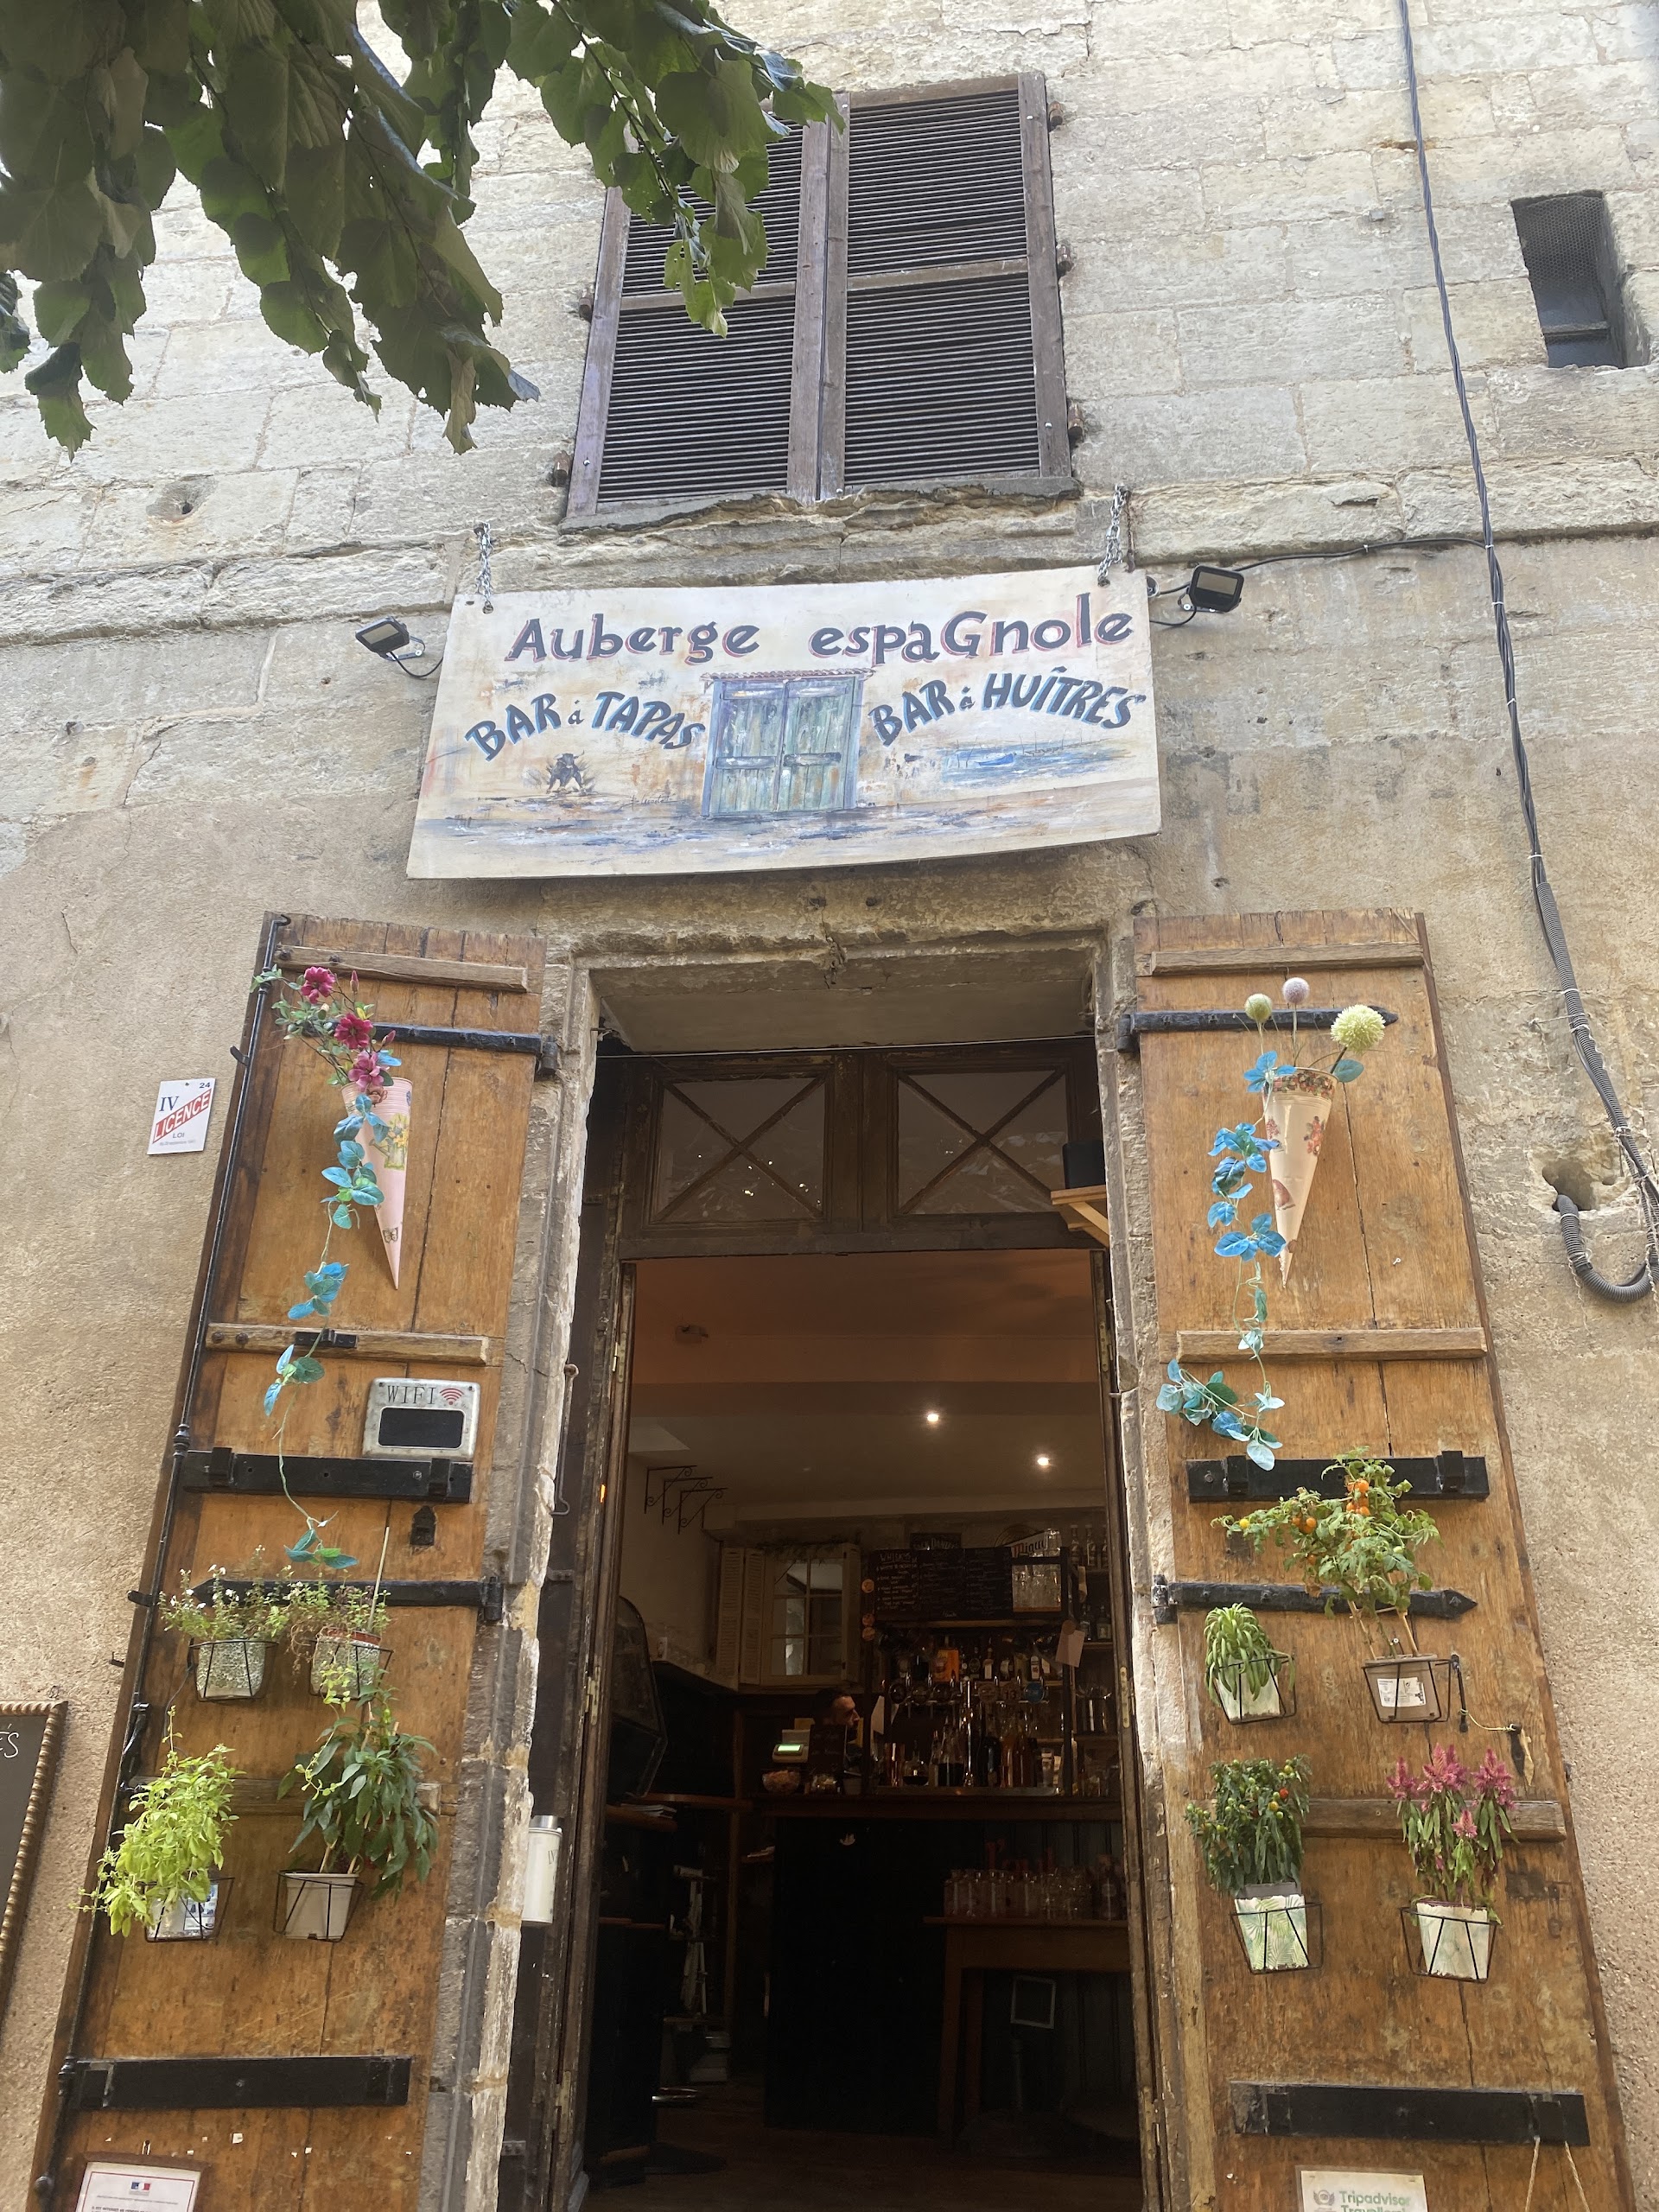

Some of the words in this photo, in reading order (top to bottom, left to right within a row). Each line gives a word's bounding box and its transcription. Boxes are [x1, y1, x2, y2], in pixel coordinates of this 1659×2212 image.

[505, 613, 760, 665] Auberge
[808, 592, 1134, 667] espaGnole
[465, 693, 562, 761] BAR
[591, 691, 706, 749] TAPAS
[868, 679, 956, 747] BAR
[982, 666, 1147, 729] HUÎTRES
[154, 1090, 210, 1140] LICENCE
[159, 1096, 180, 1112] IV
[387, 1385, 437, 1405] WIFI
[1338, 2190, 1411, 2206] Tripadvisor
